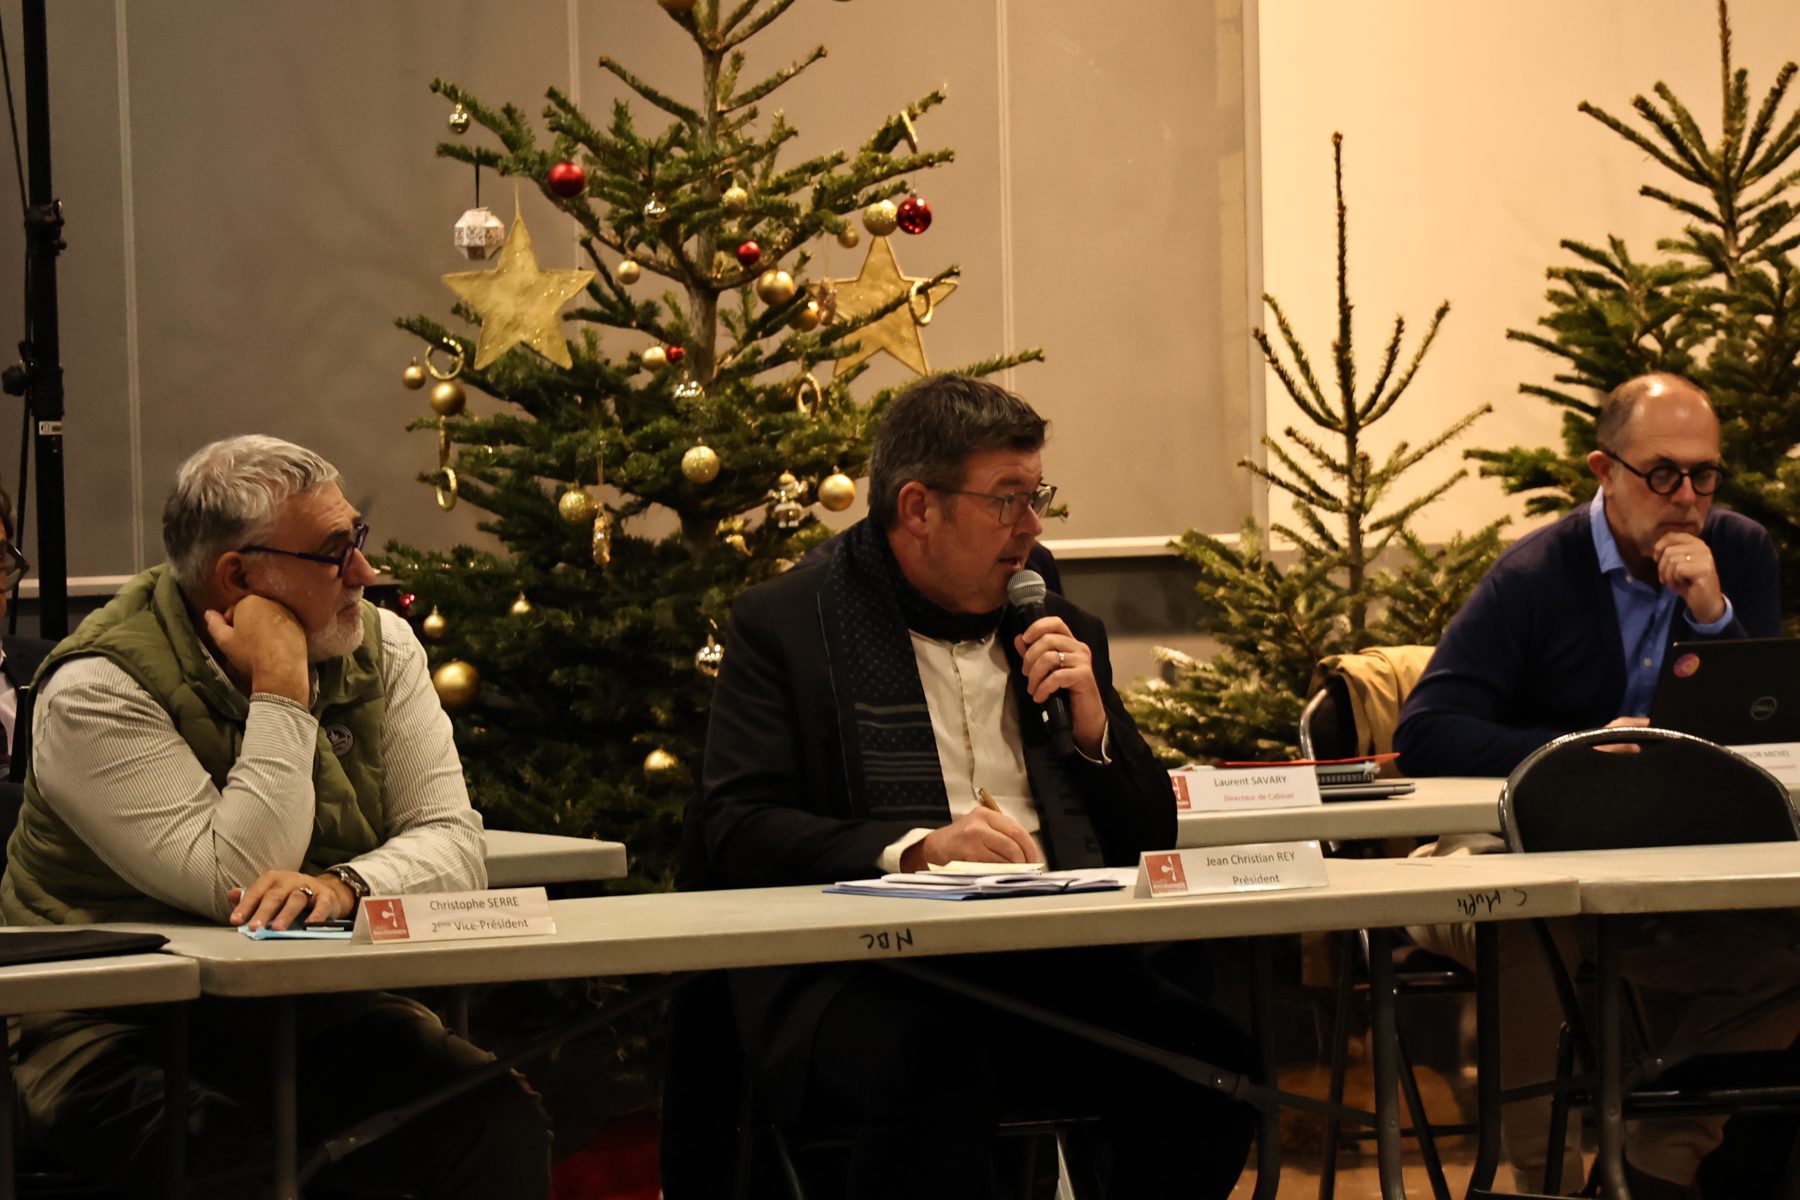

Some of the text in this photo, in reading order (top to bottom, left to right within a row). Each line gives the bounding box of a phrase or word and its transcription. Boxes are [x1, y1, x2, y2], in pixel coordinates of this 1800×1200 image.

[1213, 775, 1287, 788] Laurent SAVARY
[1223, 791, 1295, 802] Directeur de Cabinet
[1206, 851, 1296, 867] Jean Christian REY
[1232, 874, 1280, 886] Président
[429, 896, 520, 912] Christophe SERRE
[454, 918, 529, 932] Vice-Président
